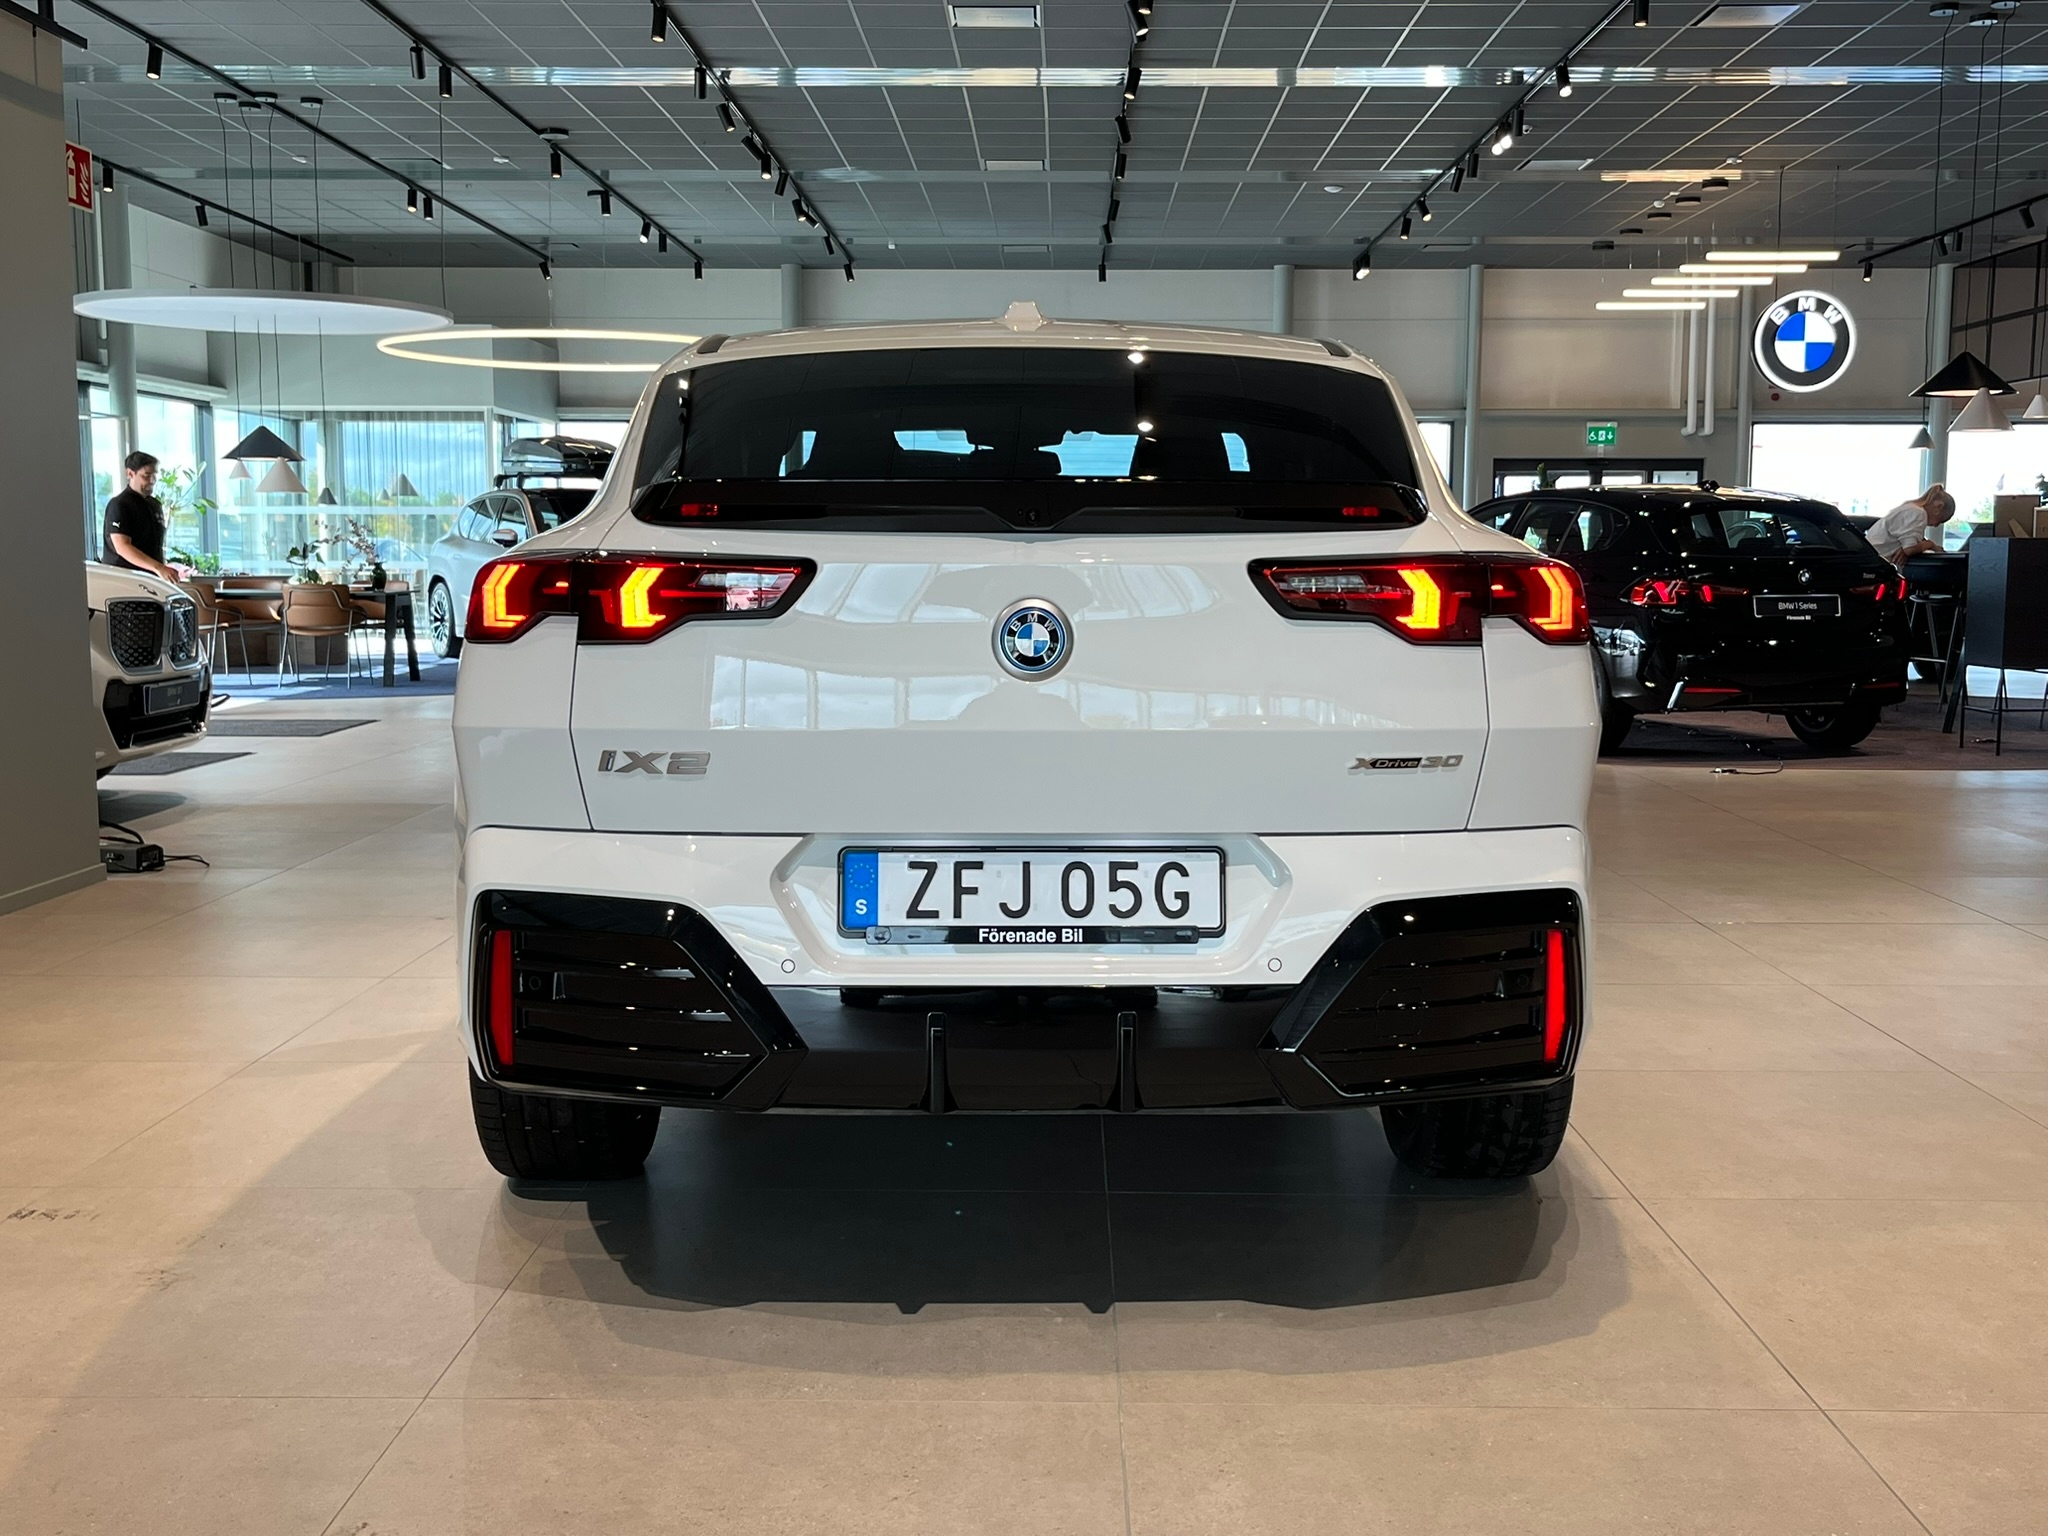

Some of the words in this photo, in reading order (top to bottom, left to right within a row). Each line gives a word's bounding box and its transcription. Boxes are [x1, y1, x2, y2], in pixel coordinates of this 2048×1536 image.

[1769, 296, 1843, 326] BMW
[1778, 602, 1794, 610] BMW
[1799, 602, 1817, 610] Series
[1010, 612, 1056, 632] BMW
[598, 750, 711, 775] iX2
[906, 861, 1031, 919] ZFJ
[1061, 861, 1190, 919] 05G
[855, 898, 868, 915] S
[978, 928, 1057, 943] Förenade
[1061, 928, 1083, 943] Bil
